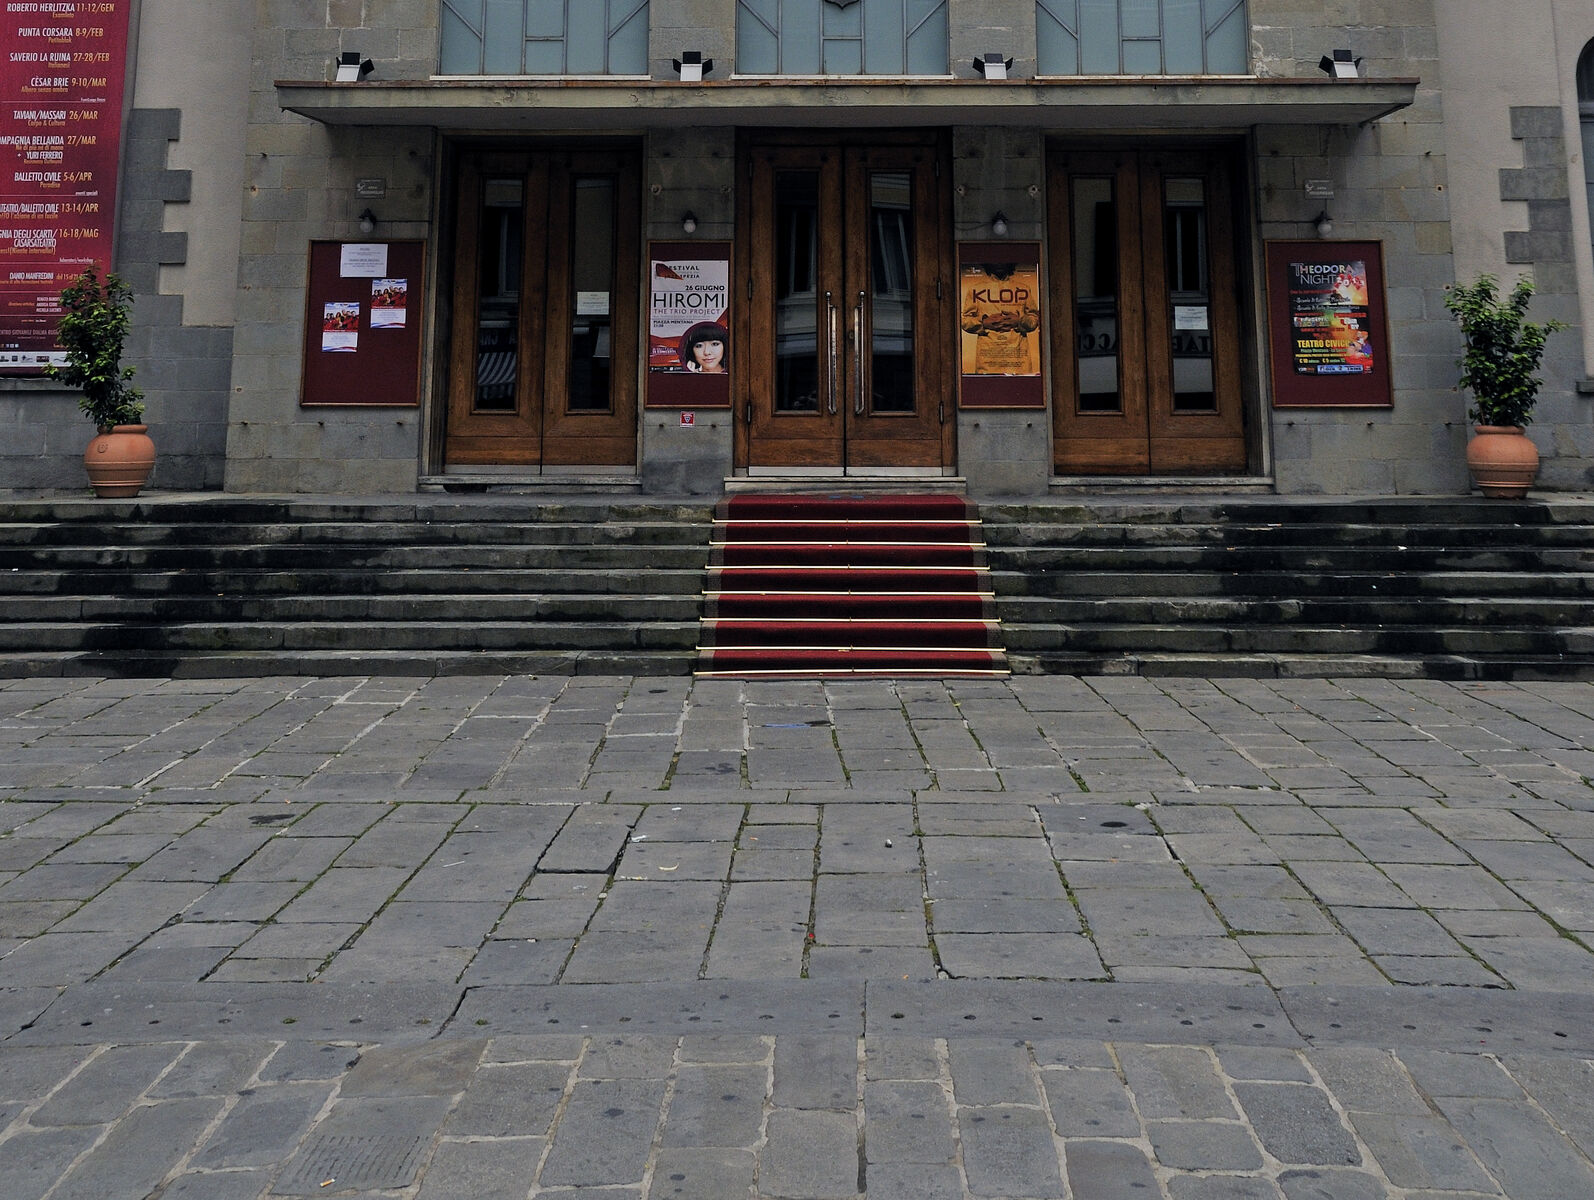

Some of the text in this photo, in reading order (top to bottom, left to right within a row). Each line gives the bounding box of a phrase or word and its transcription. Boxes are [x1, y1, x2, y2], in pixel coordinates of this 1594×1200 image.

[7, 3, 115, 14] ROBERTO HERLITZKA 11-12/GEN
[18, 27, 104, 39] PUNTA CORSARA 8-9/FEB
[10, 52, 110, 64] SAVERIO LA RUINA 27-28/FEB
[53, 77, 70, 87] BRIE
[71, 77, 107, 89] 9-10/MAR
[13, 110, 99, 122] TAVIANI/MASSARI 26/MAR
[32, 136, 65, 145] BELLANDA
[67, 135, 97, 147] 27/MAR
[26, 151, 40, 160] YURI
[40, 151, 64, 160] FERRERO
[14, 171, 93, 183] BALLETTO CIVILE 5-6/APR
[45, 203, 60, 213] CIVILE
[61, 203, 99, 215] 13-14/APR
[14, 229, 32, 239] DEGLI
[60, 229, 99, 241] 16-18/MAG
[1290, 262, 1353, 277] THEODORA
[1300, 274, 1337, 285] NIGHT
[653, 293, 725, 308] HIROMI
[1297, 339, 1350, 348] TEATRO CIVICO
